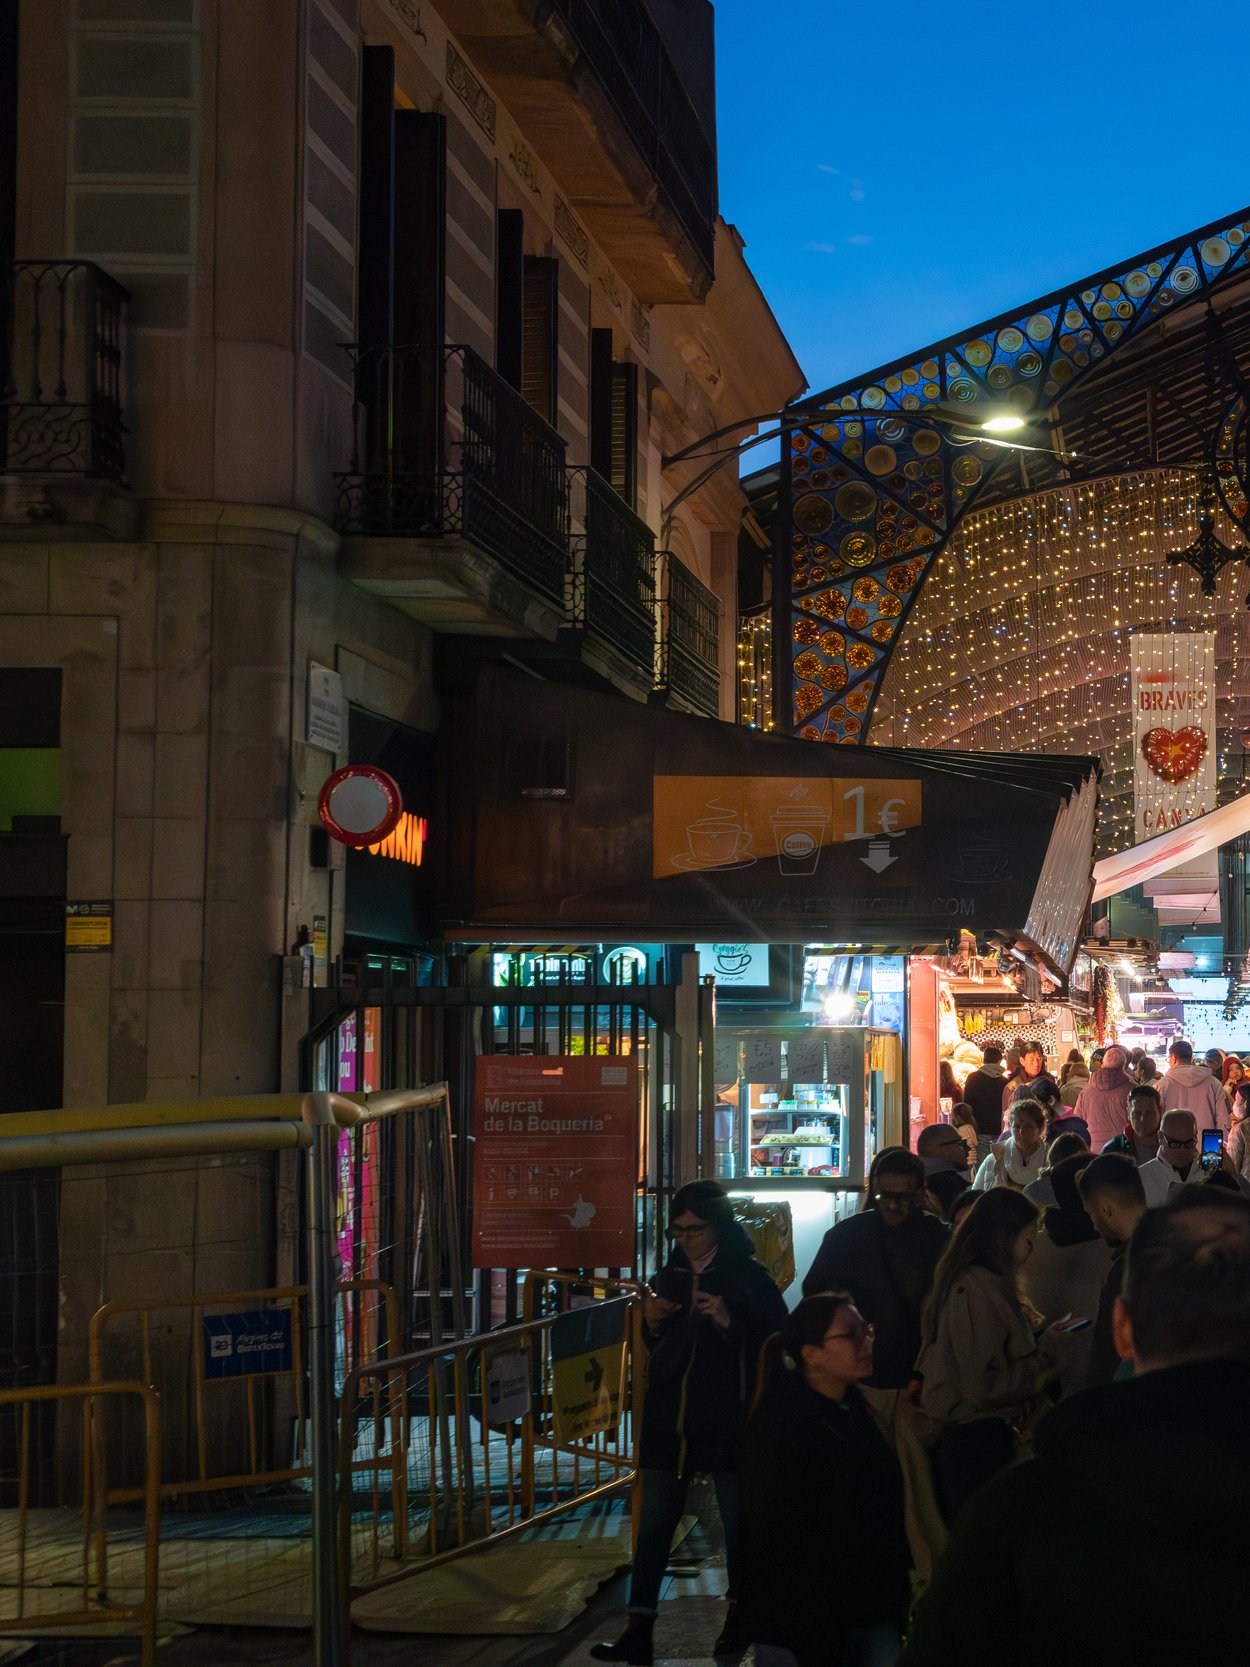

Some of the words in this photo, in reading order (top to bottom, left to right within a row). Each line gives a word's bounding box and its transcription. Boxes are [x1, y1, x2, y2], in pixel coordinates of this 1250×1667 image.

[1140, 690, 1208, 712] BRAVES
[484, 1096, 544, 1113] Mercat
[483, 1115, 505, 1132] de
[508, 1115, 523, 1132] la
[527, 1115, 605, 1135] Boqueria
